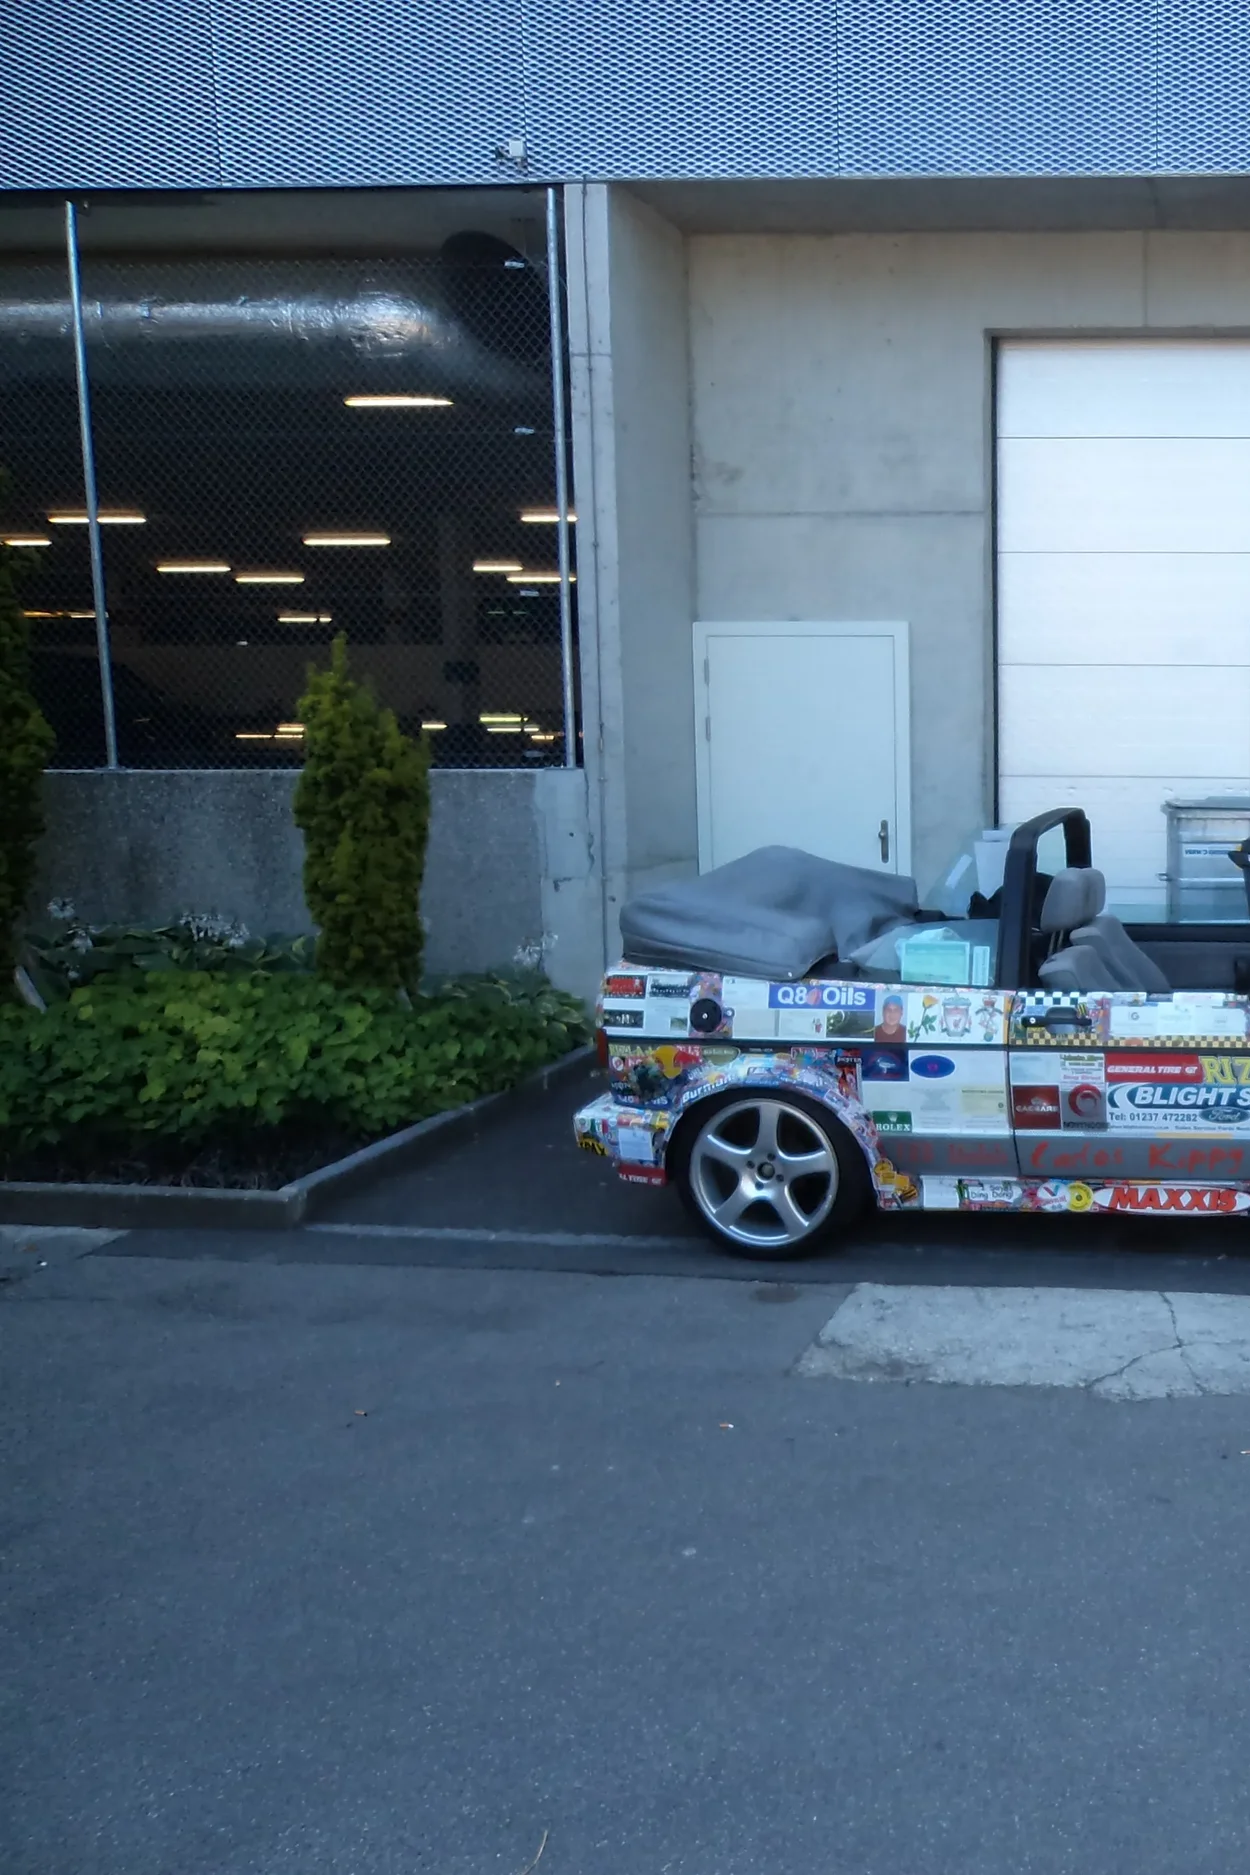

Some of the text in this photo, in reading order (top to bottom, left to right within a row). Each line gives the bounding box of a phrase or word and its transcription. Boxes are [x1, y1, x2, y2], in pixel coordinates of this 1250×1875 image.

[777, 985, 867, 1006] Q8 Oils
[1107, 1065, 1156, 1074] GENERAL
[1157, 1066, 1182, 1074] TIRE
[1109, 1112, 1198, 1122] Tel: 01237 472282
[1208, 1108, 1242, 1121] Ford
[876, 1123, 911, 1132] ROLEX
[1108, 1186, 1237, 1212] MAXXIS
